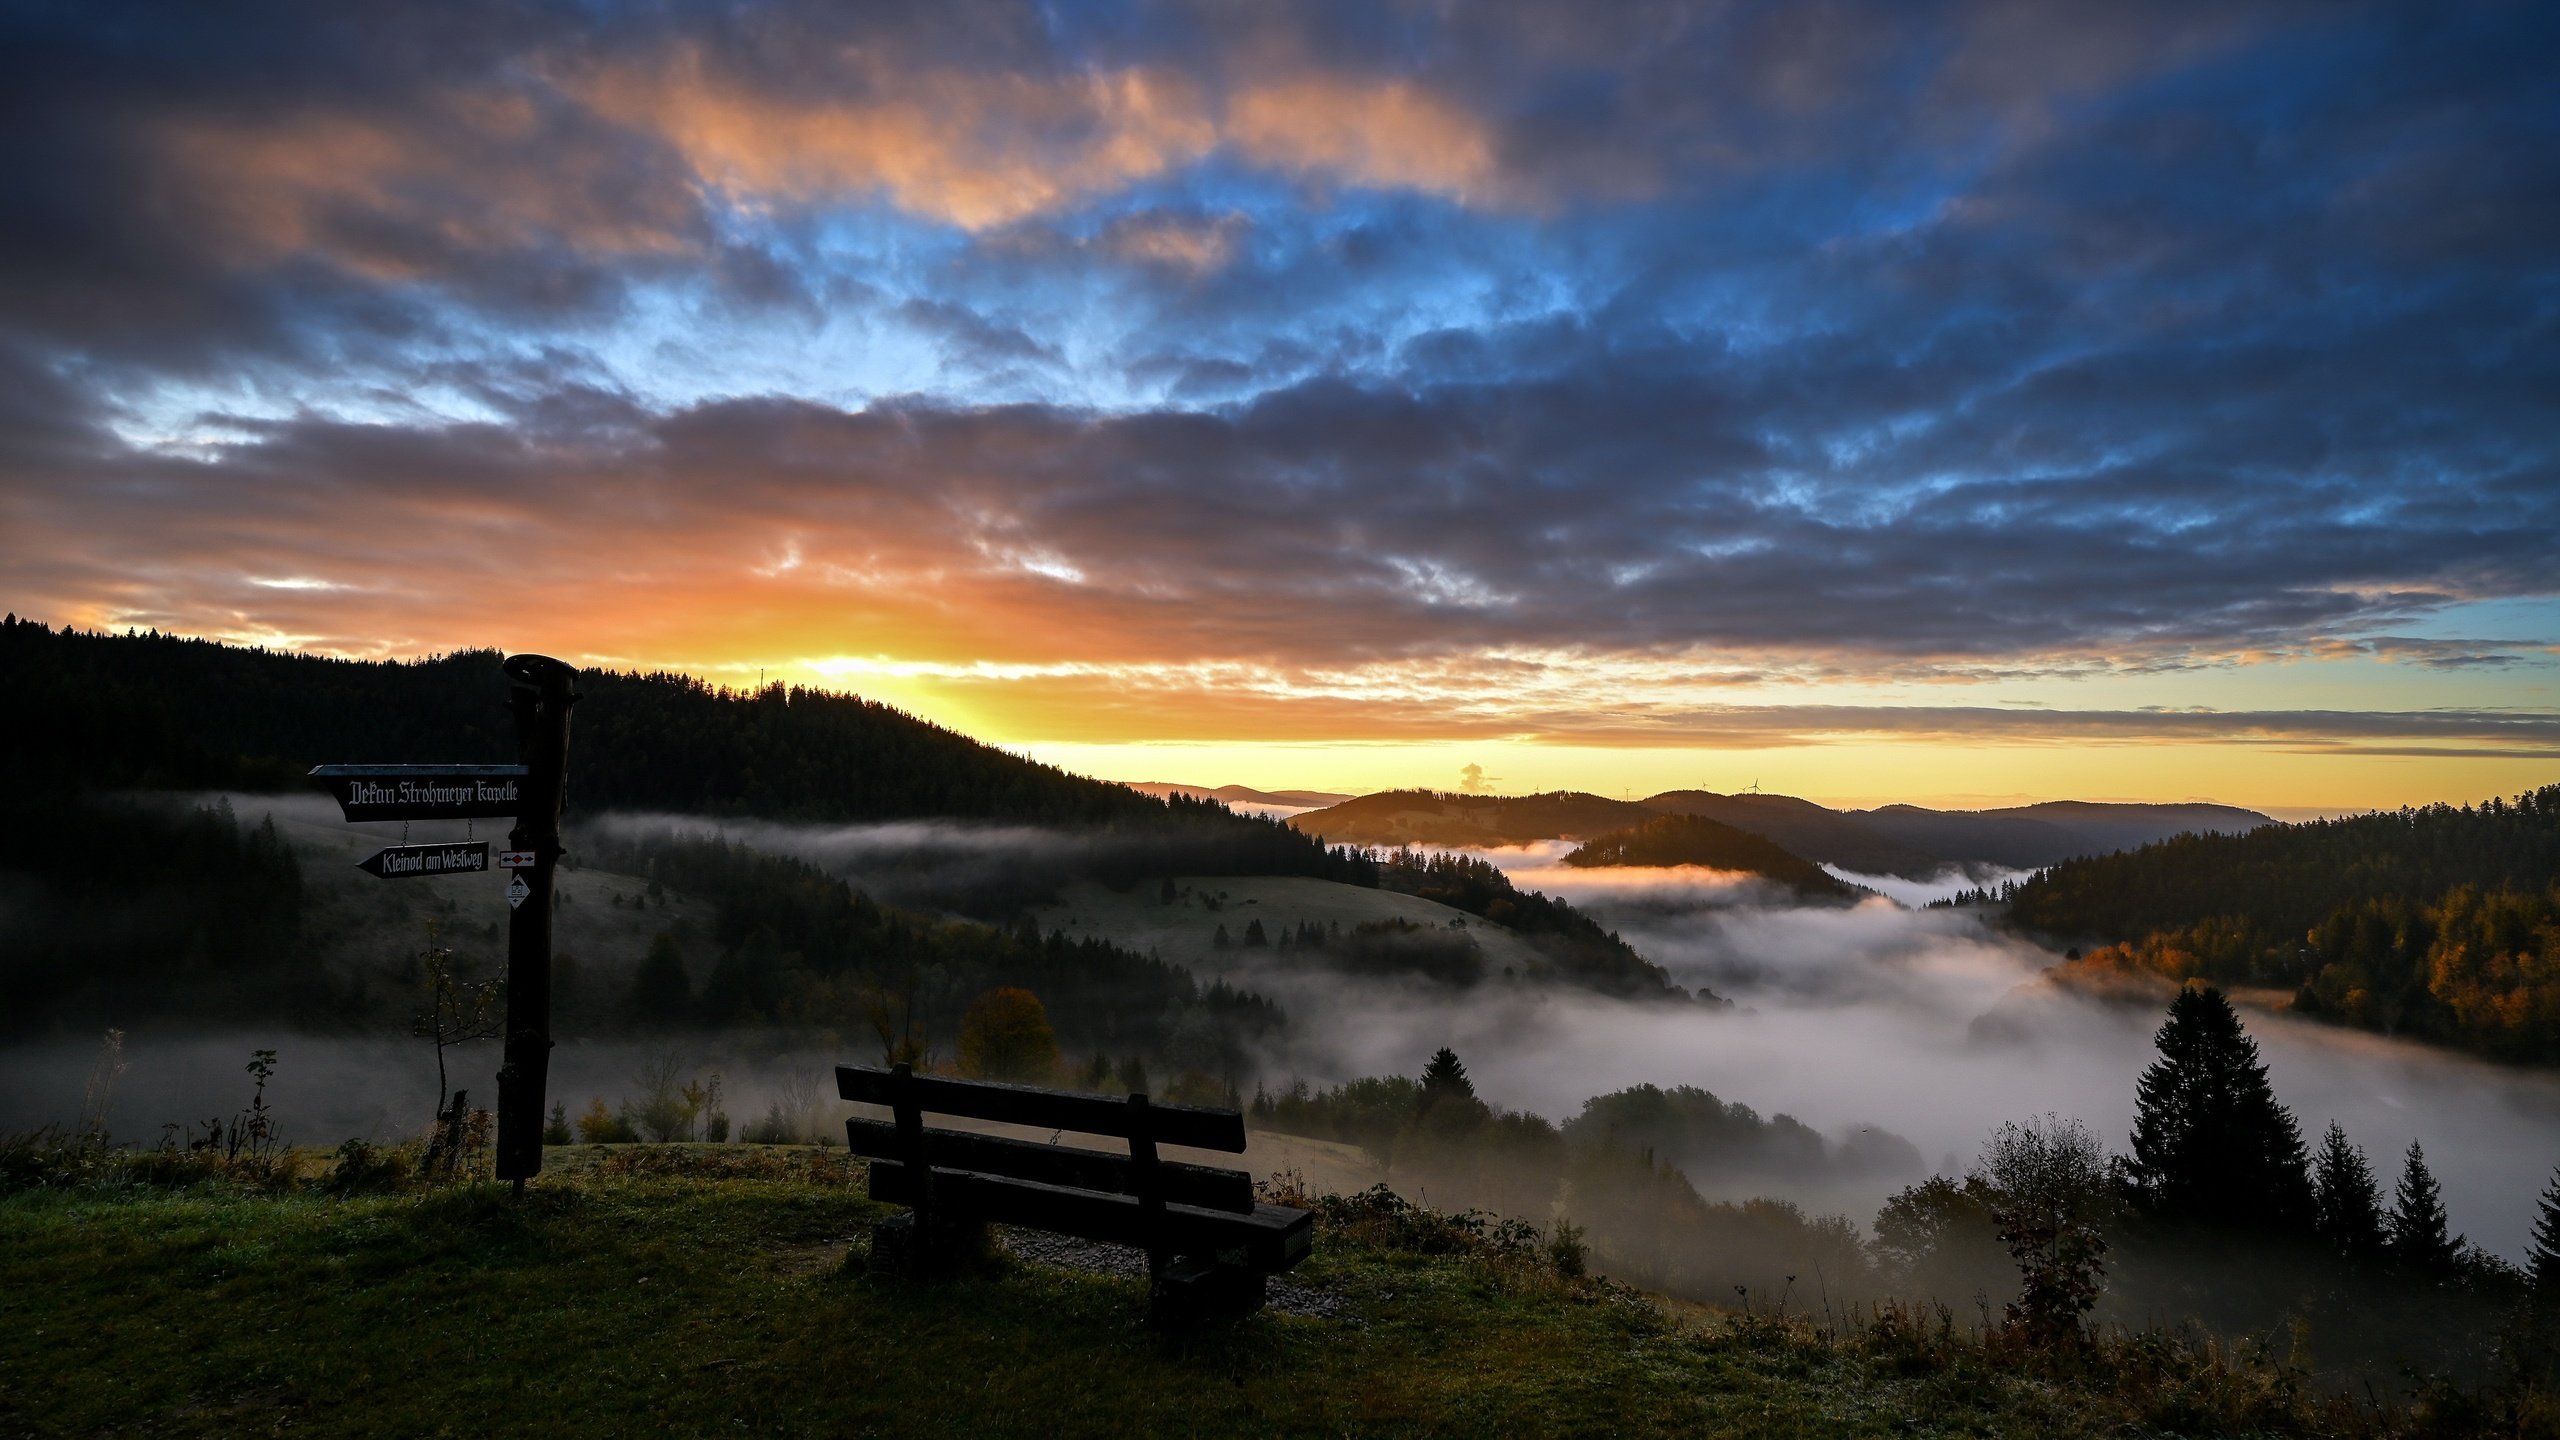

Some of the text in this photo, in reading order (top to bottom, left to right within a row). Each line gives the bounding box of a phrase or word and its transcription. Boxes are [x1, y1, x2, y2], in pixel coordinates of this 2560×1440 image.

[348, 781, 395, 806] Dekan
[398, 780, 474, 807] Strohmeyer
[382, 849, 483, 874] Kleinod am Westweg
